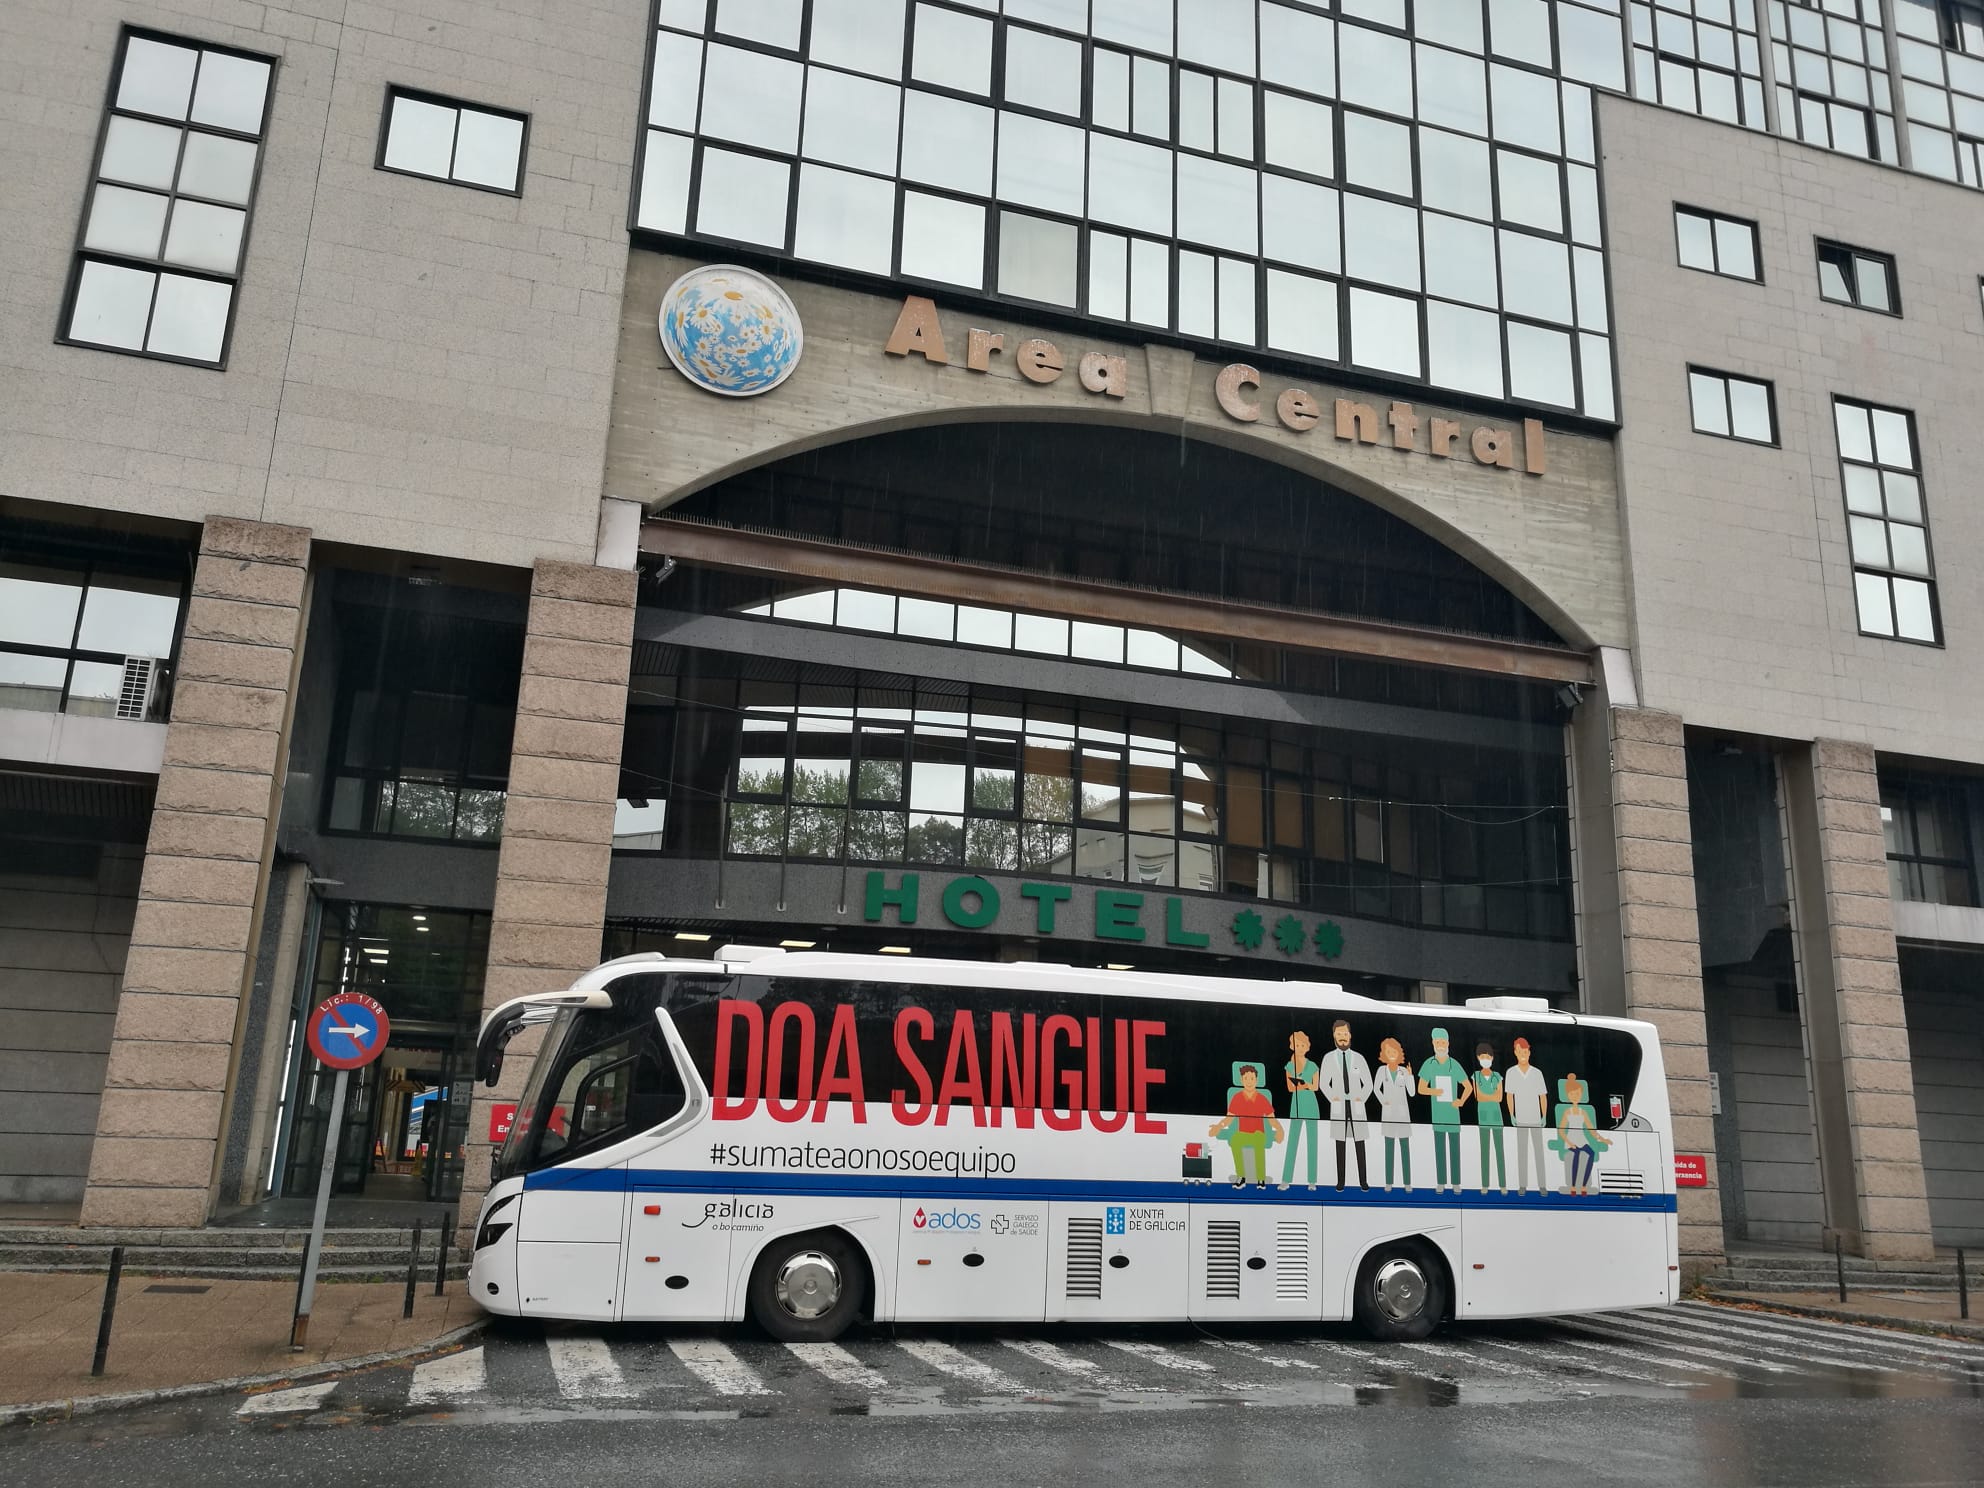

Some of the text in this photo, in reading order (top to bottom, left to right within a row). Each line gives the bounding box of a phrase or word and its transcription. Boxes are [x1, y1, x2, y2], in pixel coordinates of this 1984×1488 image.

[884, 295, 1545, 476] Area Central
[863, 871, 1210, 948] HOTEL
[358, 995, 383, 1014] 1/98
[711, 999, 1168, 1135] DOA SANGUE
[709, 1141, 1017, 1180] #sumateaonosoequipo
[681, 1198, 775, 1229] galicia
[720, 1222, 731, 1231] bo
[928, 1207, 981, 1230] ados
[1129, 1208, 1165, 1219] XUNTA
[1129, 1220, 1186, 1231] DE GALICIA
